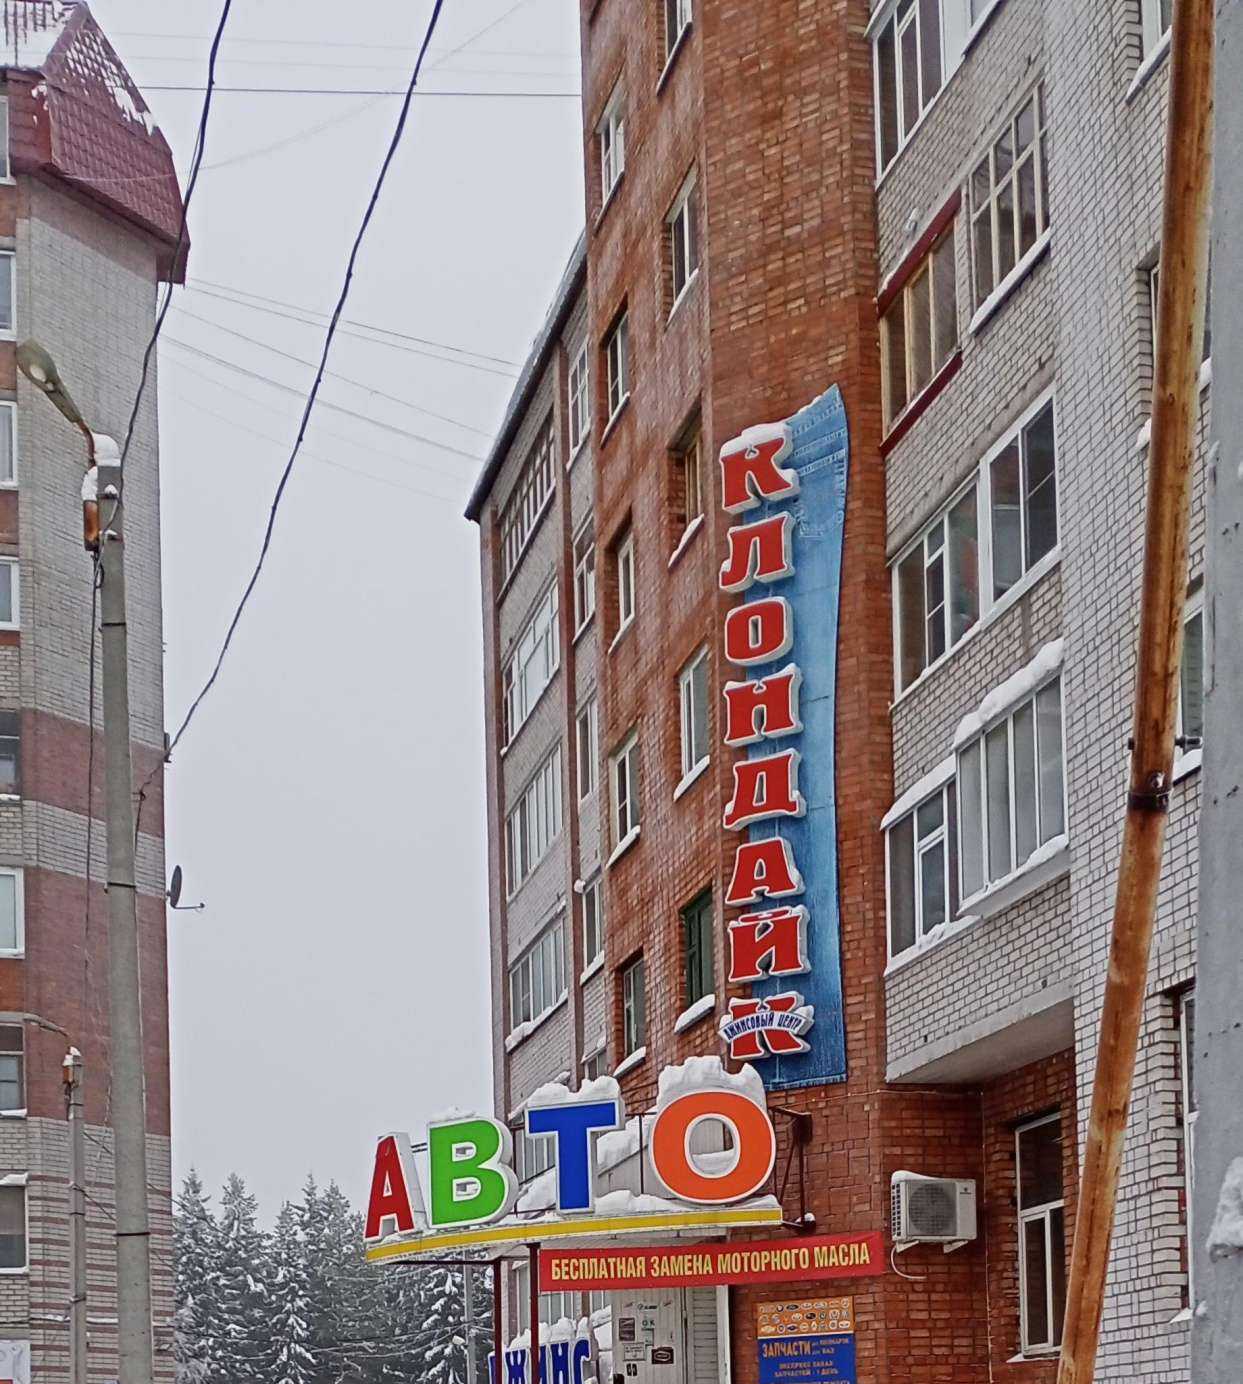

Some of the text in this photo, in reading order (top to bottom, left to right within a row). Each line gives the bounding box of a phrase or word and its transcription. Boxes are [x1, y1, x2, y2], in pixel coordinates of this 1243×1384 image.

[720, 426, 805, 1059] КЛОНДАЙК
[723, 1012, 802, 1041] ДЖИНСОВЫЙ ЦЕНТР
[364, 1089, 776, 1240] АВТО
[551, 1242, 871, 1281] БЕСПЛАТНАЯ ЗАМЕНА МОТОРНОГО МАСЛА
[762, 1340, 811, 1358] ЗАПЧАСТИ
